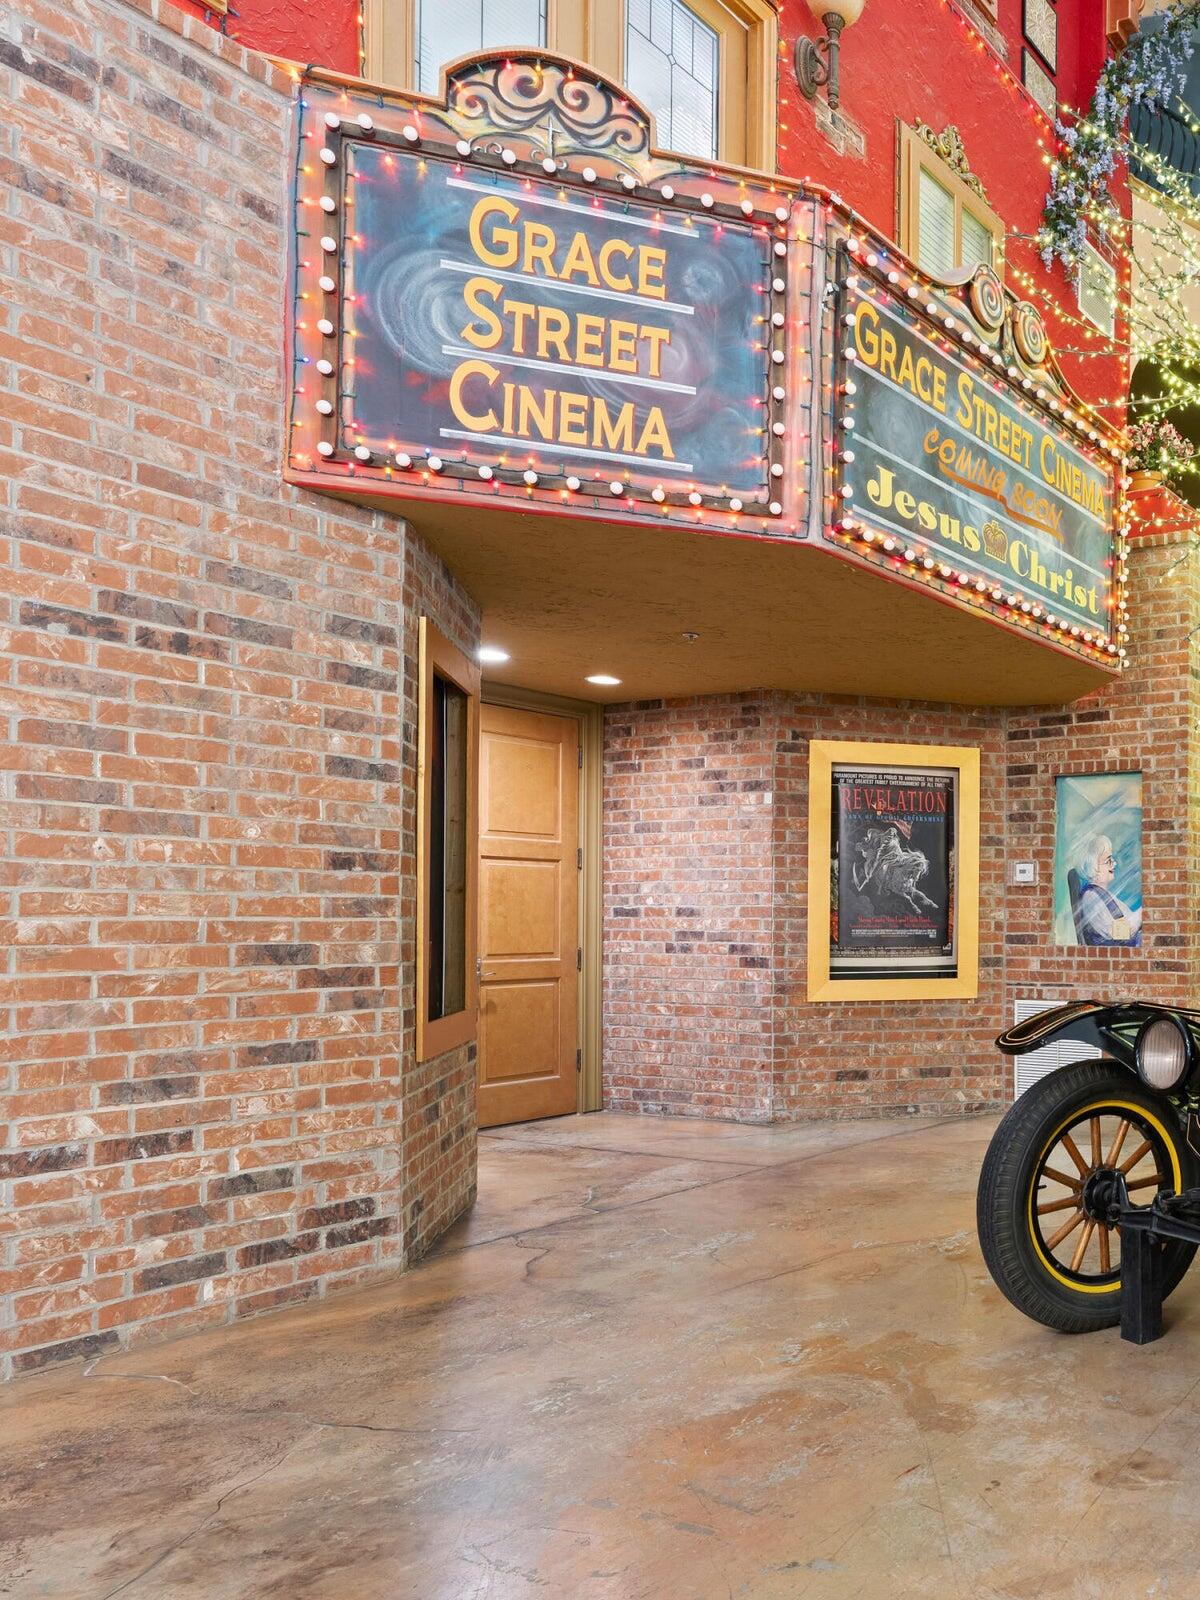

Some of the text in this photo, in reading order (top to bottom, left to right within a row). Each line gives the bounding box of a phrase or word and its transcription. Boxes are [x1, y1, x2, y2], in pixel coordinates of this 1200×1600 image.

[469, 196, 667, 300] GRACE
[460, 277, 671, 378] STREET
[449, 360, 676, 459] CINEMA
[854, 300, 1106, 521] GRACE STREET CINEMA
[923, 427, 1063, 529] COMING SOON
[867, 464, 1100, 615] Jesus Christ
[841, 788, 947, 813] REVELATION
